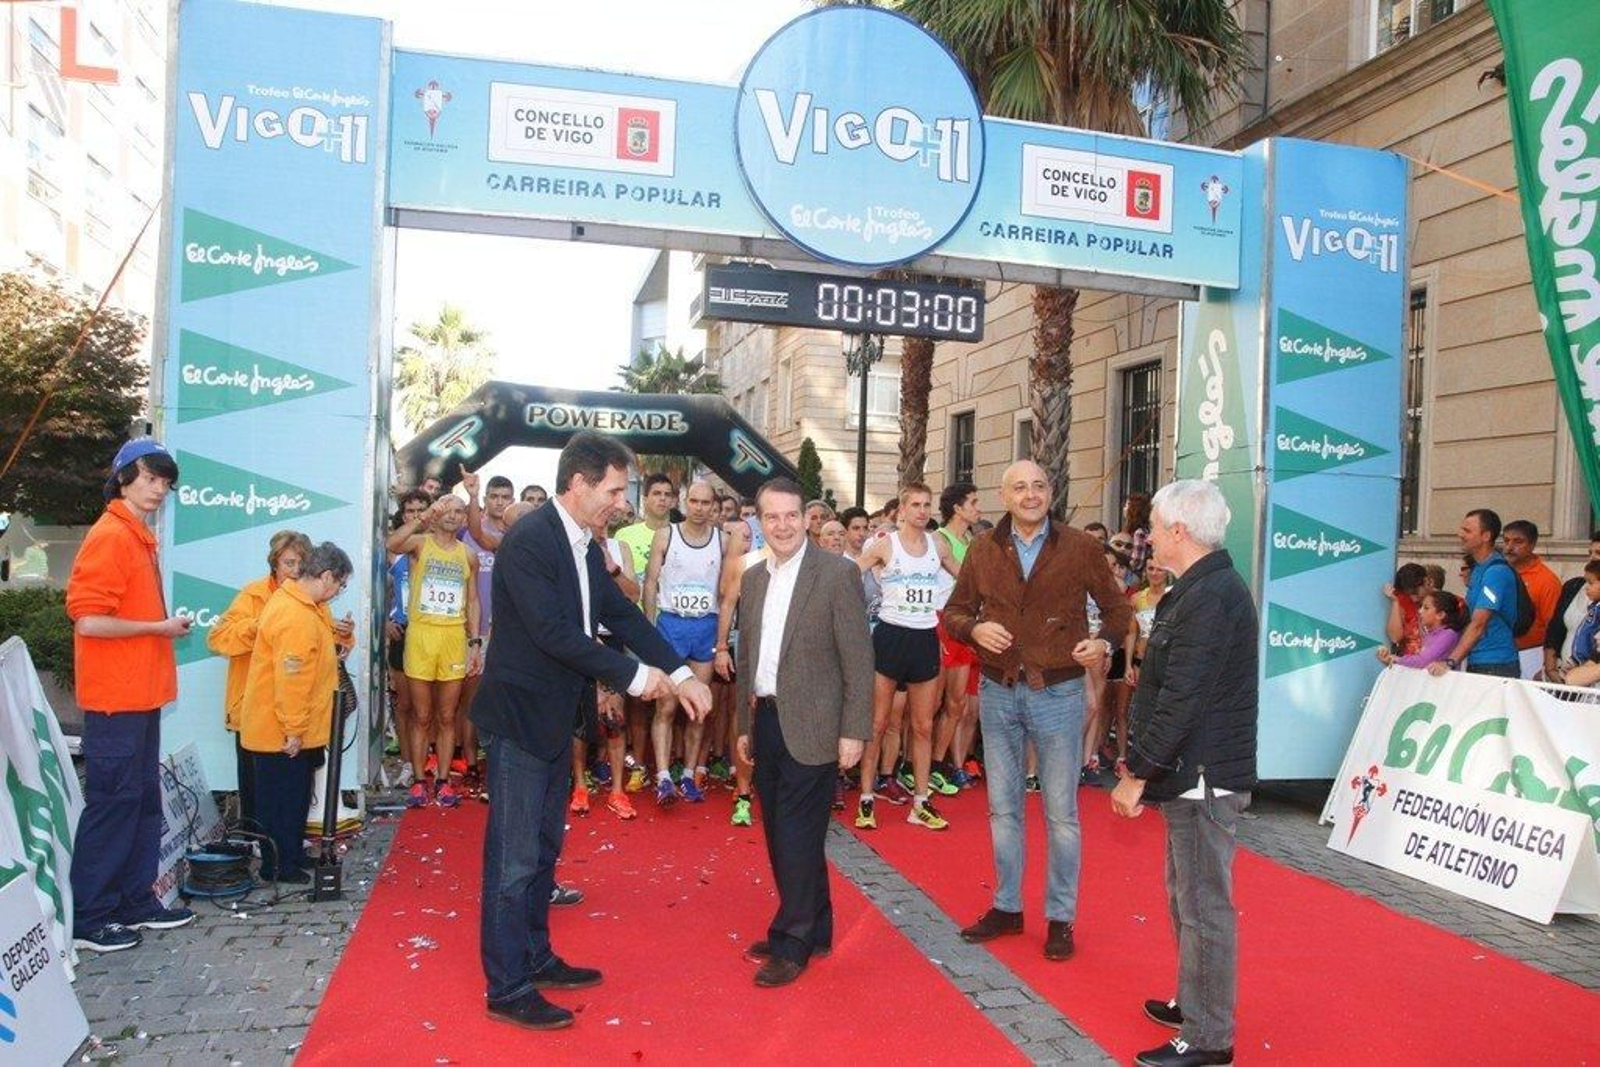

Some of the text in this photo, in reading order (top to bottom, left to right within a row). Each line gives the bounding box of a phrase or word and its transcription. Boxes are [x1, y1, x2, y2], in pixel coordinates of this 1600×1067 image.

[515, 108, 604, 129] CONCELLO
[524, 127, 594, 145] DE VIGO
[487, 173, 721, 208] CARREIRA POPULAR
[1042, 167, 1117, 189] CONCELLO
[1051, 184, 1108, 204] DE VIGO
[790, 204, 933, 244] El Corte Inglés
[875, 205, 920, 220] Trofeo
[979, 220, 1174, 259] CARREIRA POPULAR
[186, 243, 319, 276] El Corte Inglés
[816, 283, 977, 334] 00:03:00
[1279, 336, 1367, 364] El Corte Inglés
[182, 364, 314, 395] El Corte Inglés
[527, 405, 680, 432] POWERADE
[1277, 434, 1365, 460] El Corte Inglés
[178, 484, 311, 516] El Corte Inglés
[1273, 532, 1361, 557] El Corte Inglés
[428, 590, 456, 604] 103
[673, 595, 710, 610] 1026
[906, 588, 933, 604] 811
[1269, 629, 1357, 654] El Corte Inglés
[1392, 789, 1566, 861] FEDERACIÓN GALEGA
[1404, 832, 1518, 889] DE ATLETISMO
[2, 922, 47, 971] DEPORTE
[10, 947, 51, 992] GALEGO
